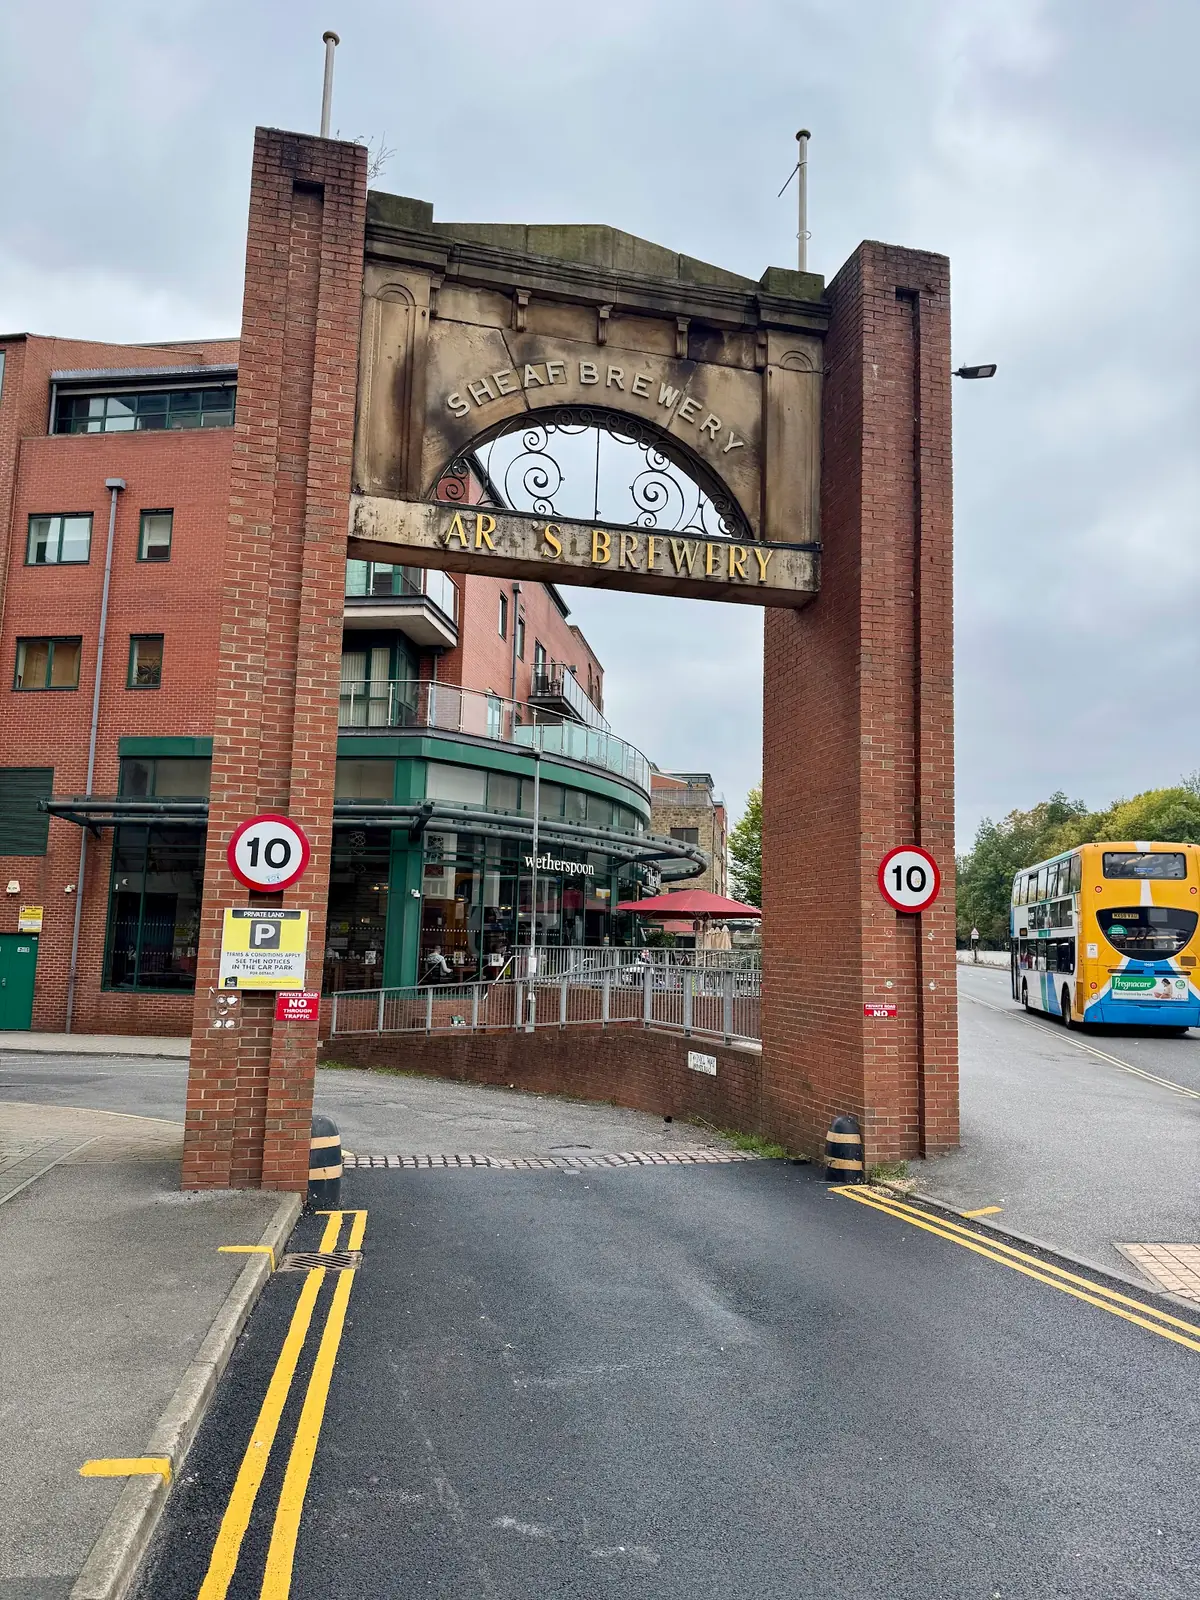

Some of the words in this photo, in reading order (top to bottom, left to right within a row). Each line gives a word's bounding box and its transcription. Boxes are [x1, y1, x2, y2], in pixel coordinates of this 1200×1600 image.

[447, 360, 566, 418] SHEAF
[579, 361, 745, 454] BREWERY
[591, 529, 775, 584] BREWERY
[246, 836, 292, 870] 10
[523, 851, 595, 877] wetherspoon
[892, 864, 927, 893] 10
[254, 923, 276, 946] P
[1114, 977, 1152, 990] Pregnacare
[288, 999, 308, 1008] NO
